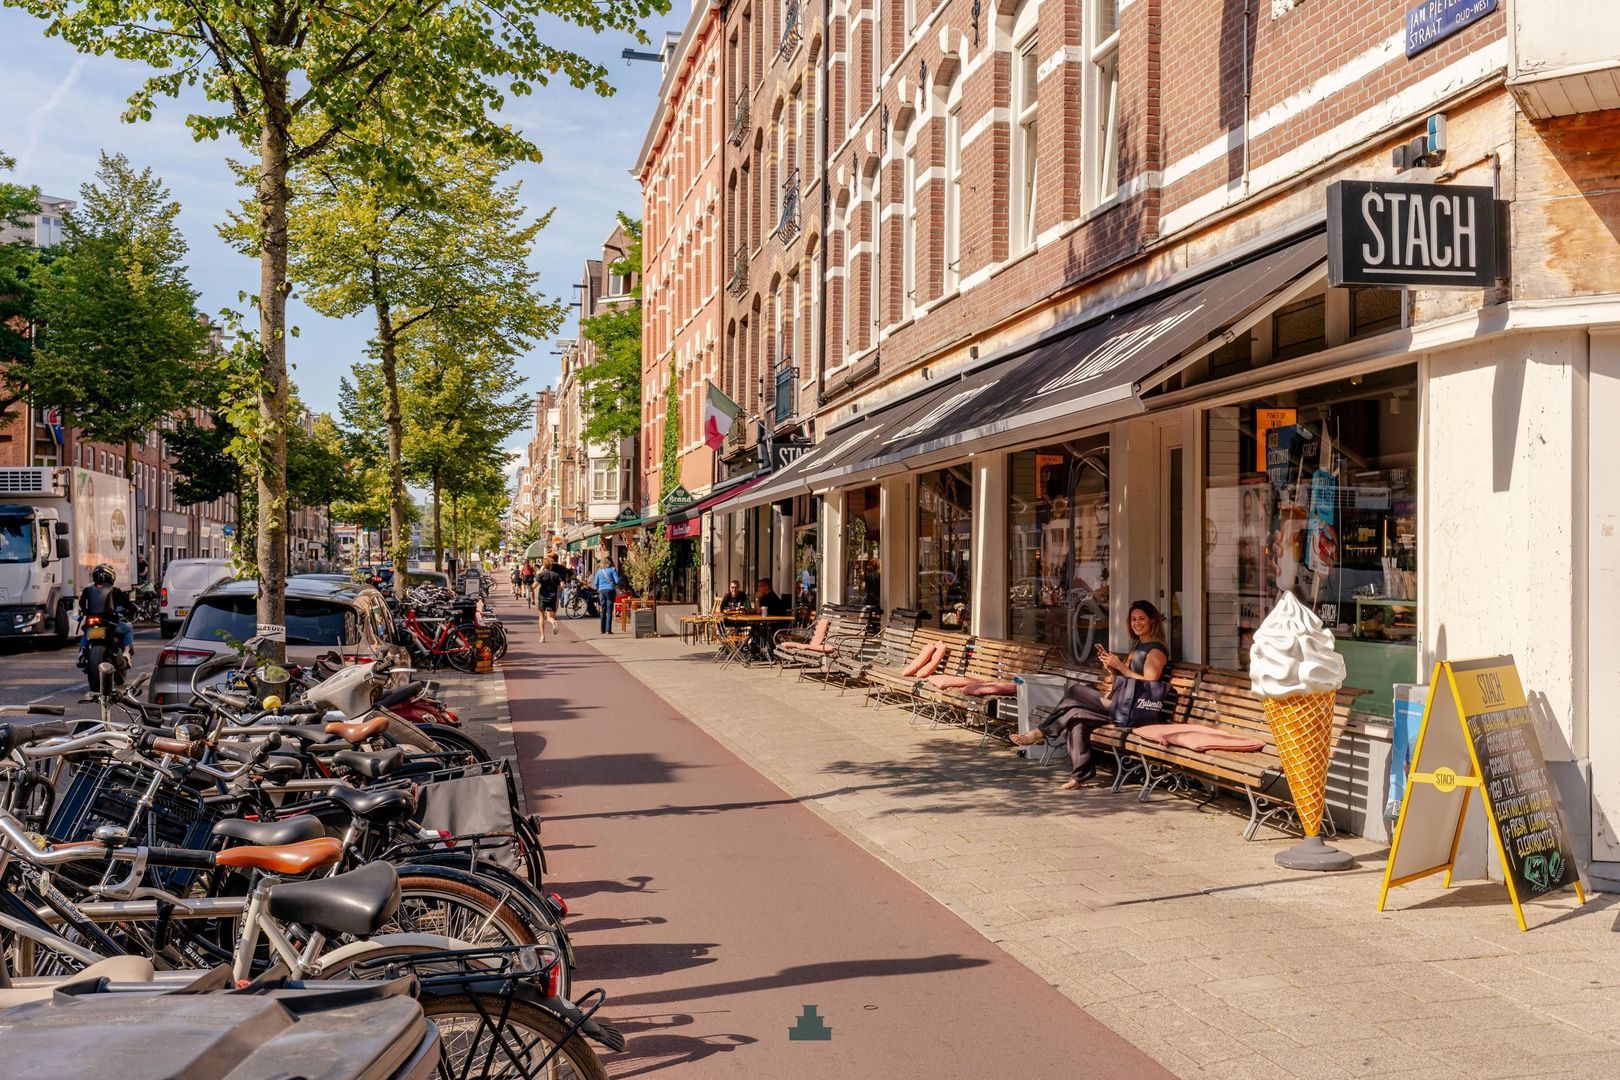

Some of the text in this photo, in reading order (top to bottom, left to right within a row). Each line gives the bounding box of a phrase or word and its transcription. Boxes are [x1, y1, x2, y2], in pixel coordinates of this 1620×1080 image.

[1410, 0, 1461, 34] JAN PIET
[1455, 0, 1489, 24] OUD-WEST
[1409, 18, 1442, 49] STRAAT
[1362, 191, 1476, 268] STACH
[668, 495, 692, 503] Brand
[619, 512, 637, 520] Brand
[1321, 603, 1337, 620] STACH
[1476, 671, 1505, 704] STACH
[1436, 773, 1455, 785] STACH
[1503, 776, 1516, 795] TEA
[1510, 816, 1528, 838] FRESH
[1527, 810, 1548, 832] LEMON
